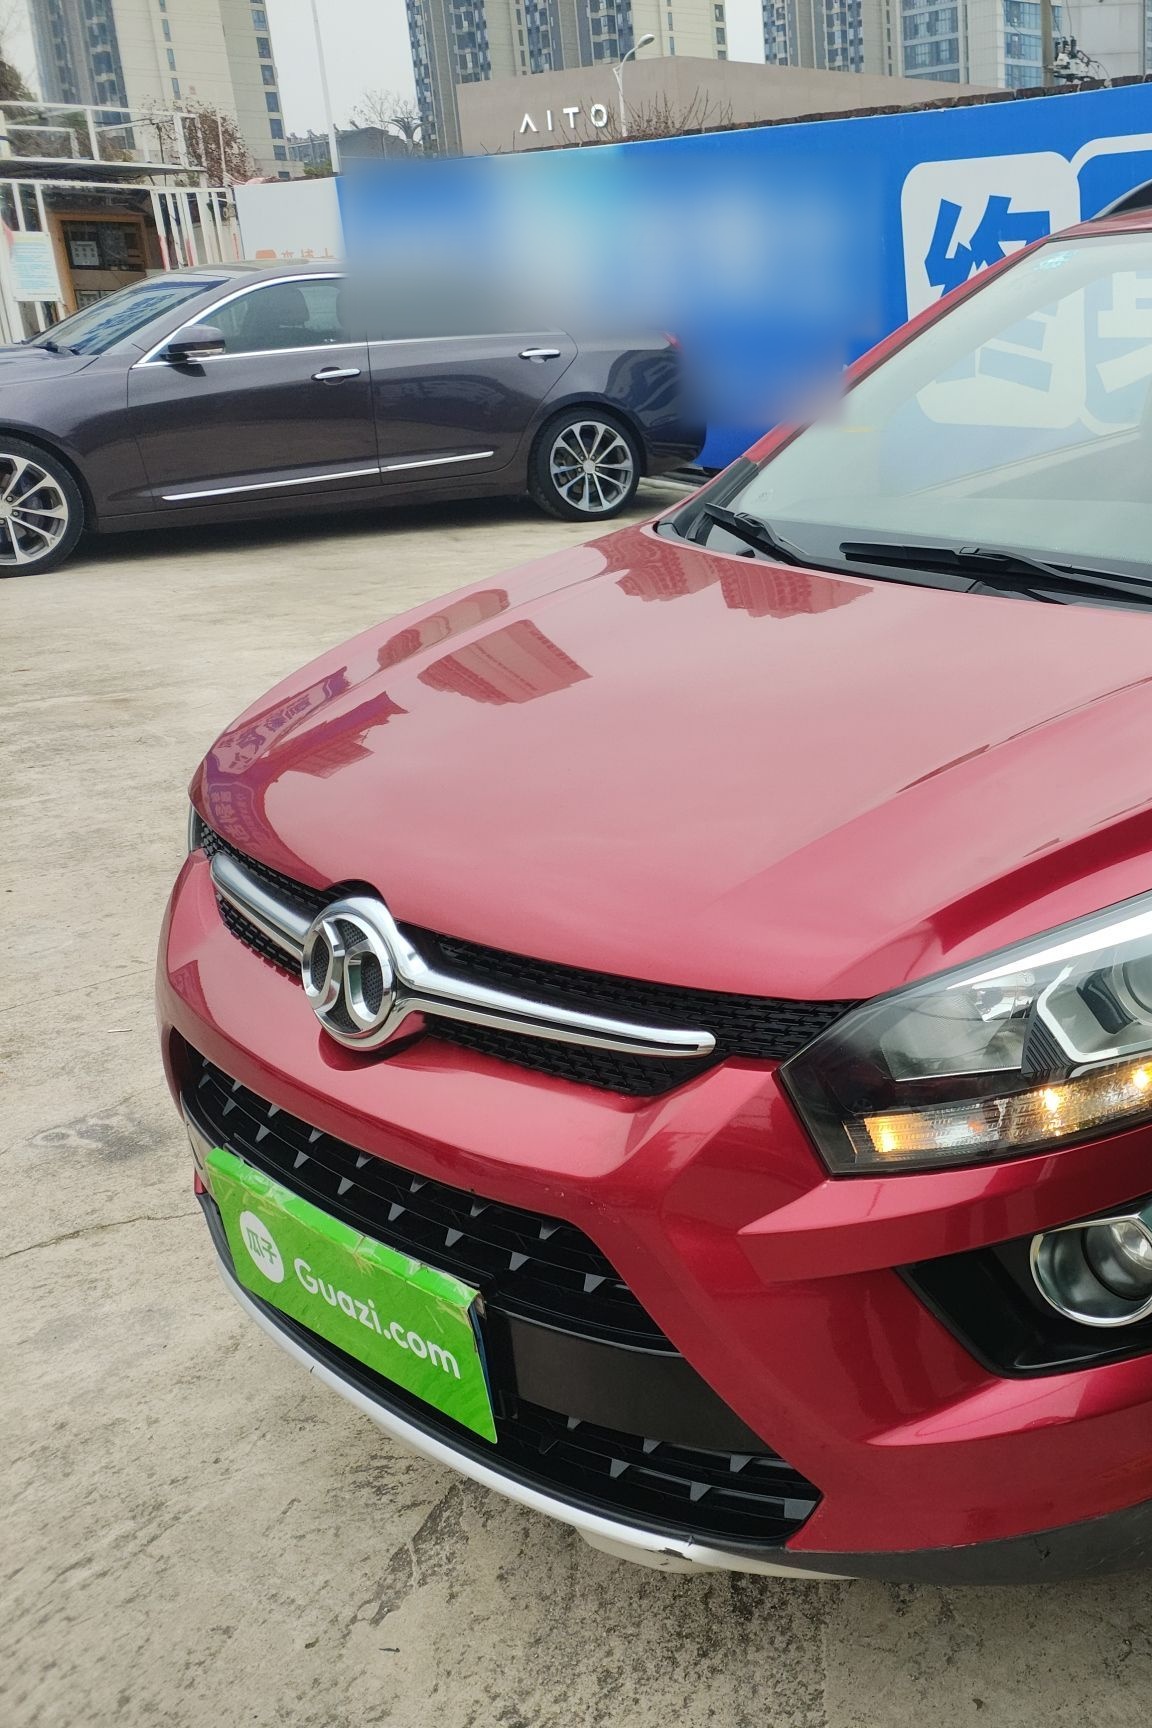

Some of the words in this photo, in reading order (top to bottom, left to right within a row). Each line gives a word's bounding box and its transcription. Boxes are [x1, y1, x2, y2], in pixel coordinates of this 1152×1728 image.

[519, 103, 608, 133] AITO
[246, 1227, 277, 1265] 瓜子
[293, 1258, 461, 1380] Guazi.com
